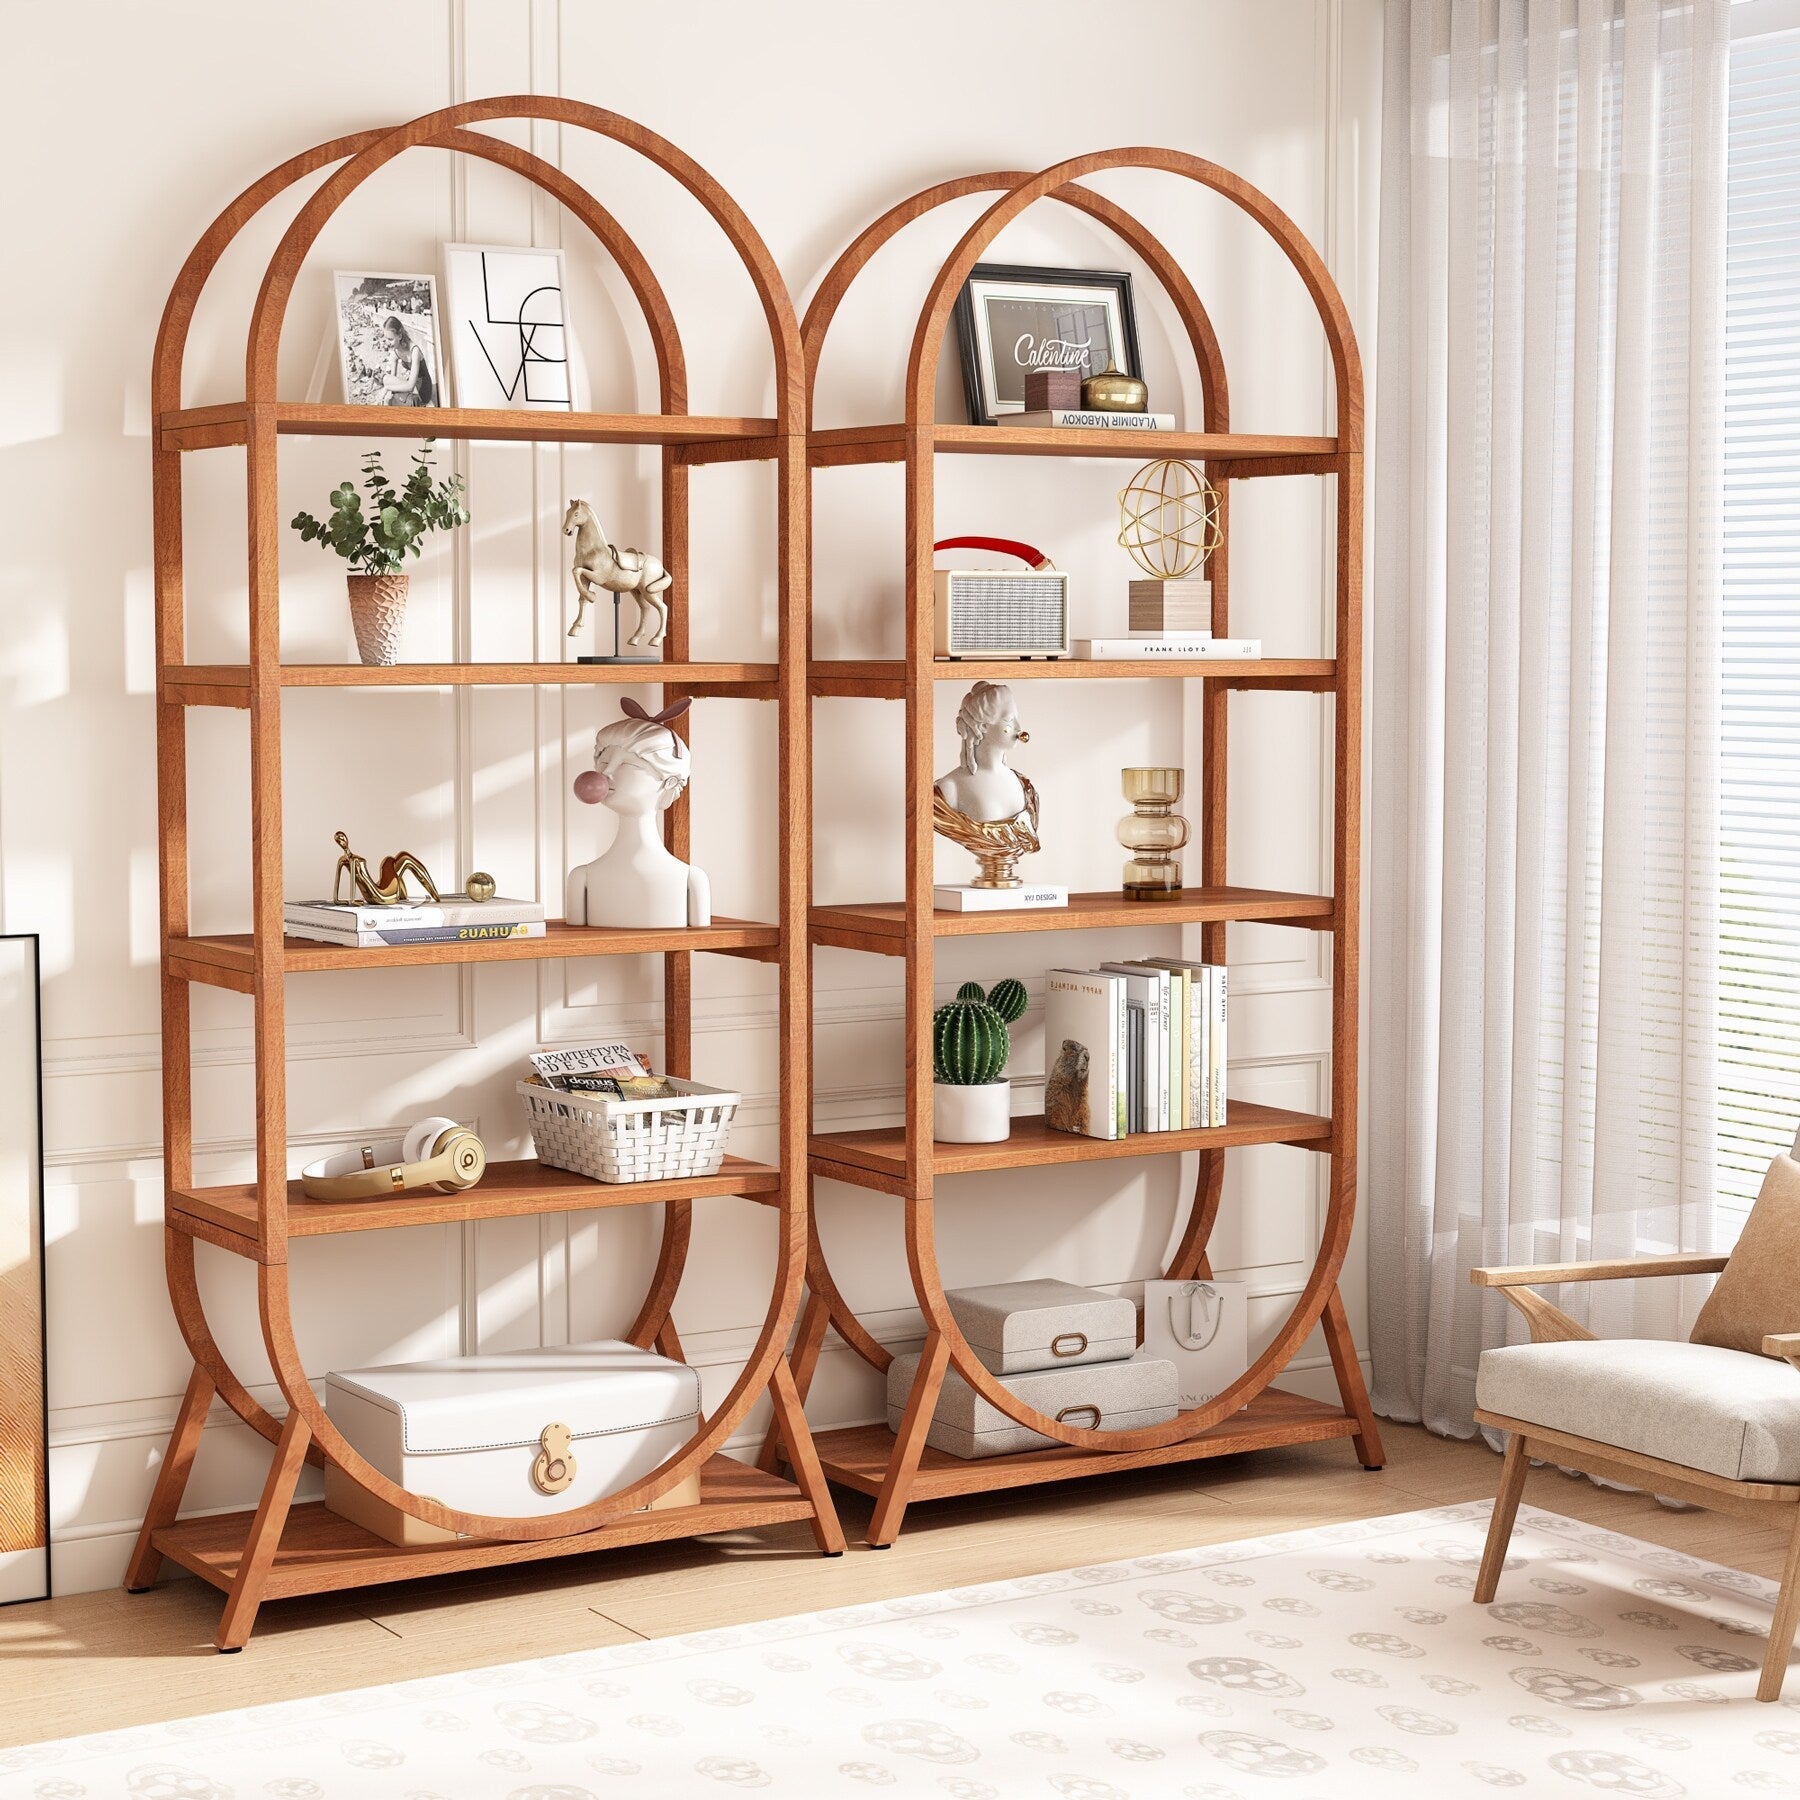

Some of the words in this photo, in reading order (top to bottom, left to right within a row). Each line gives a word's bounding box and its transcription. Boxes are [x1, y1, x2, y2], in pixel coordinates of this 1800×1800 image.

[1014, 333, 1092, 373] Calentine
[1062, 414, 1110, 428] NABOKOV
[1112, 416, 1157, 429] VLADIMIR
[537, 1044, 629, 1065] АРХИТЕКТУРА
[549, 1053, 632, 1073] DESIGN
[569, 1076, 615, 1087] domus
